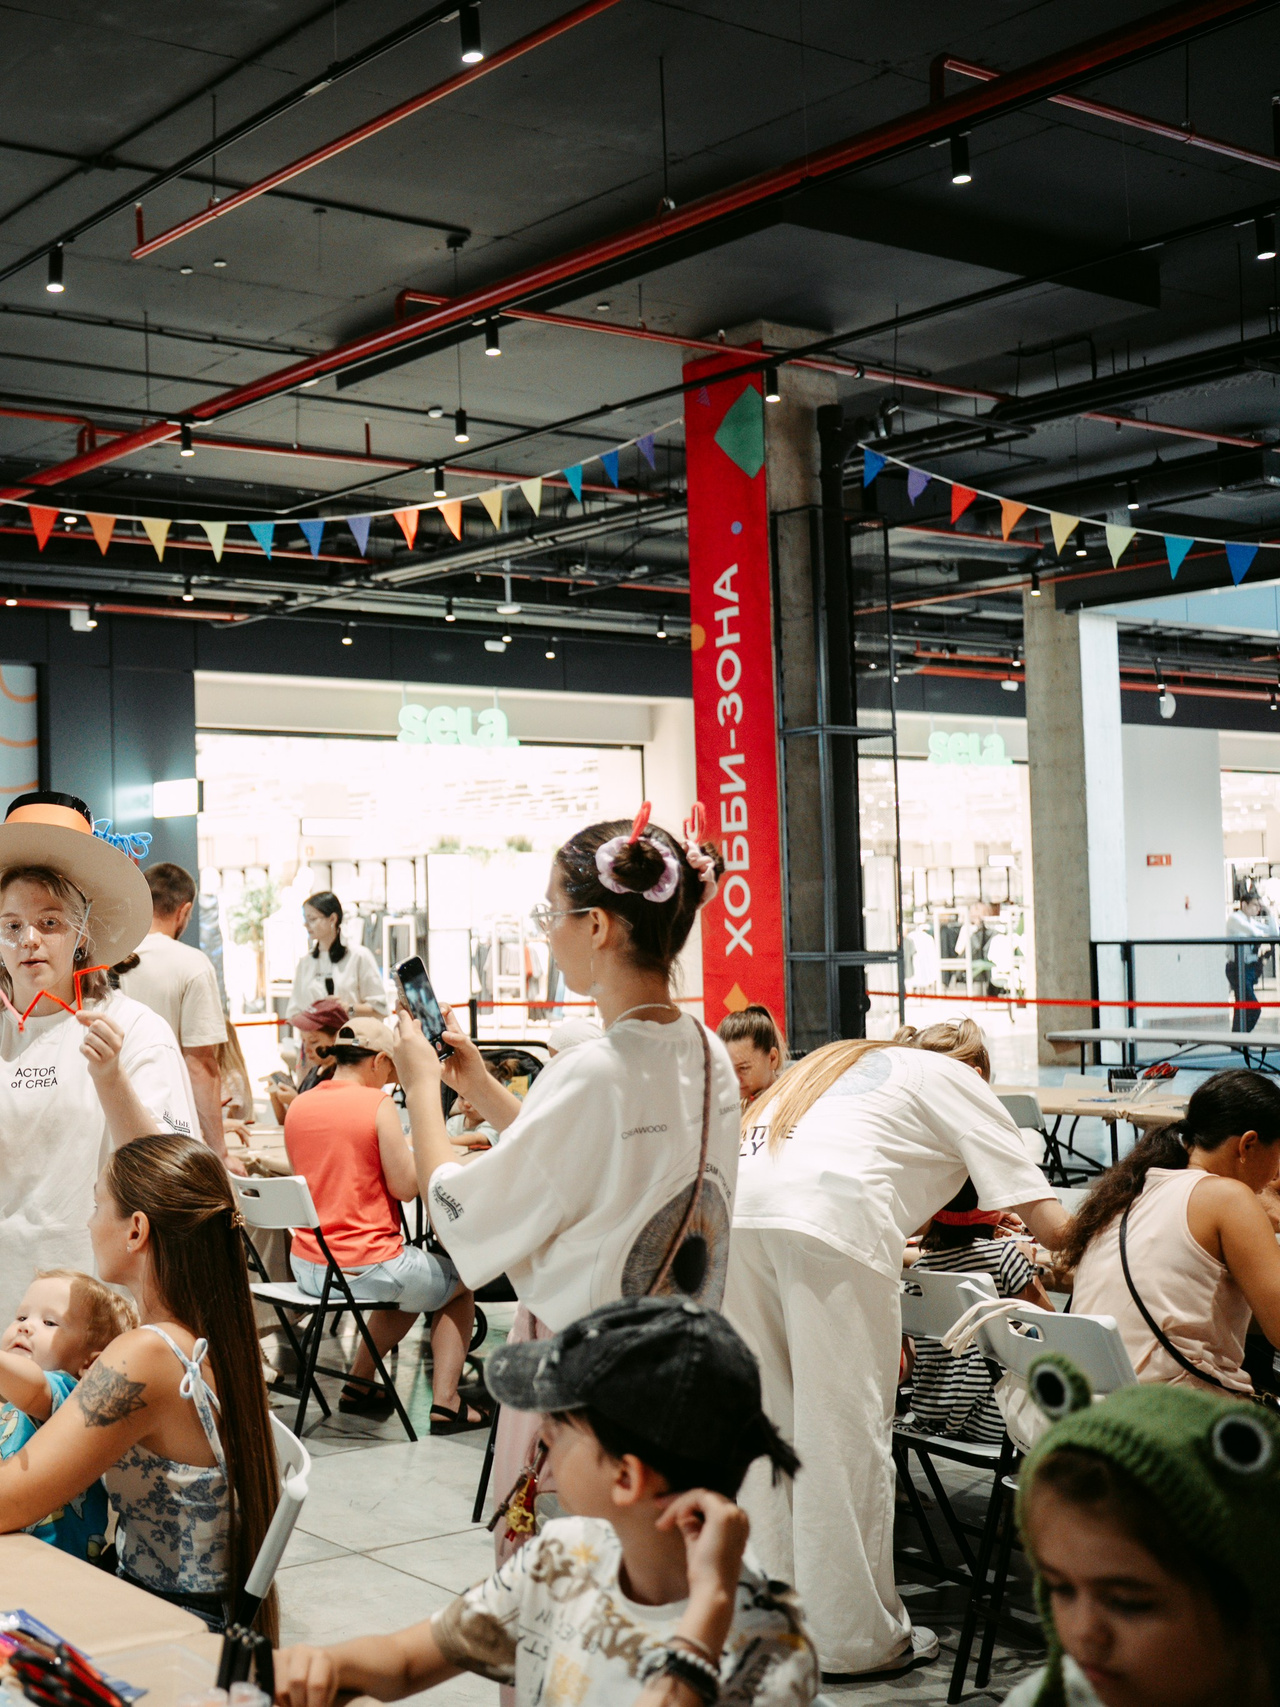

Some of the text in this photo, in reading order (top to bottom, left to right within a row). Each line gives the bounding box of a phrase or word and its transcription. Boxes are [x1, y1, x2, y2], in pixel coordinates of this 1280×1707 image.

[713, 563, 753, 957] ХОББИ-ЗОНА
[15, 1066, 56, 1079] ACTOR
[11, 1077, 58, 1090] of CREA
